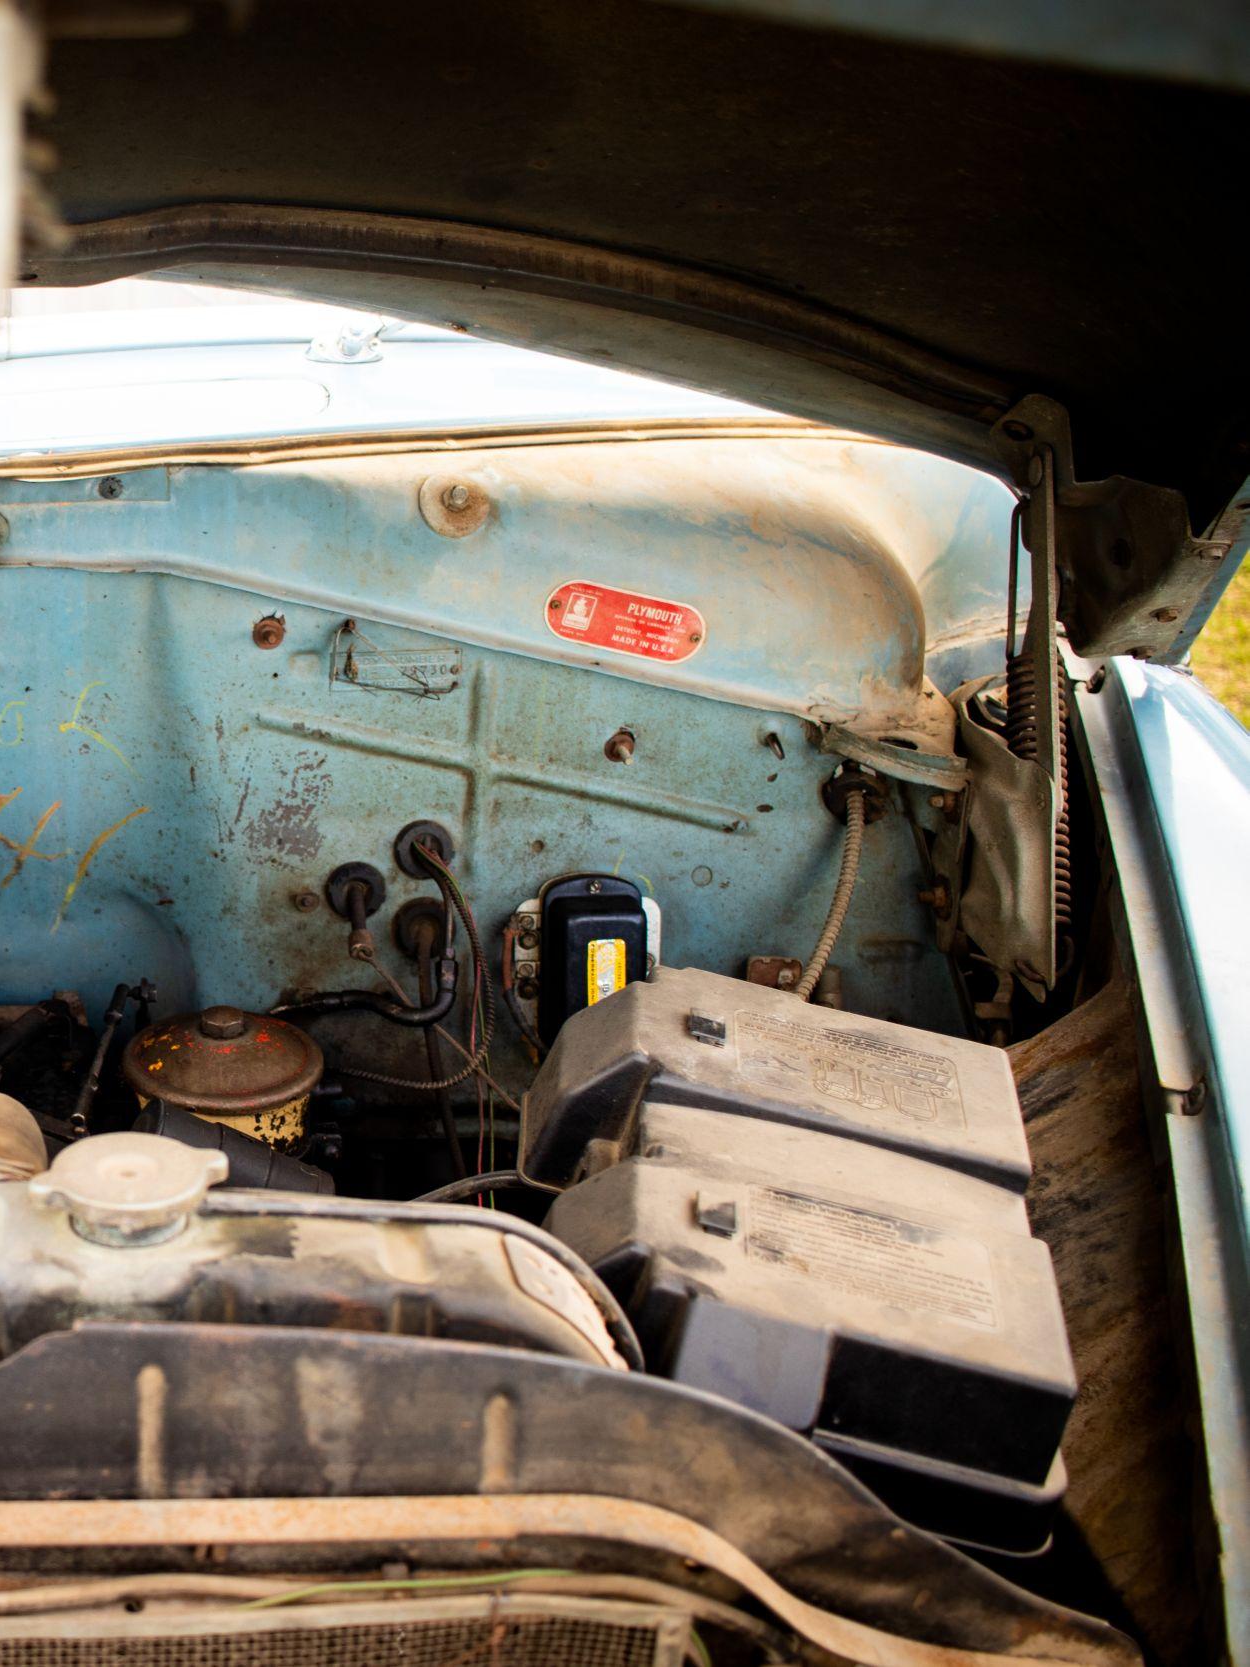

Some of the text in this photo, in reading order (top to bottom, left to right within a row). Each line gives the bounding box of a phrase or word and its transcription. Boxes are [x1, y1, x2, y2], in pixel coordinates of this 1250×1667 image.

[627, 603, 683, 625] PLYMOUTH
[611, 633, 637, 647] MADE
[639, 640, 650, 649] IN
[646, 632, 680, 645] MICHIGAN
